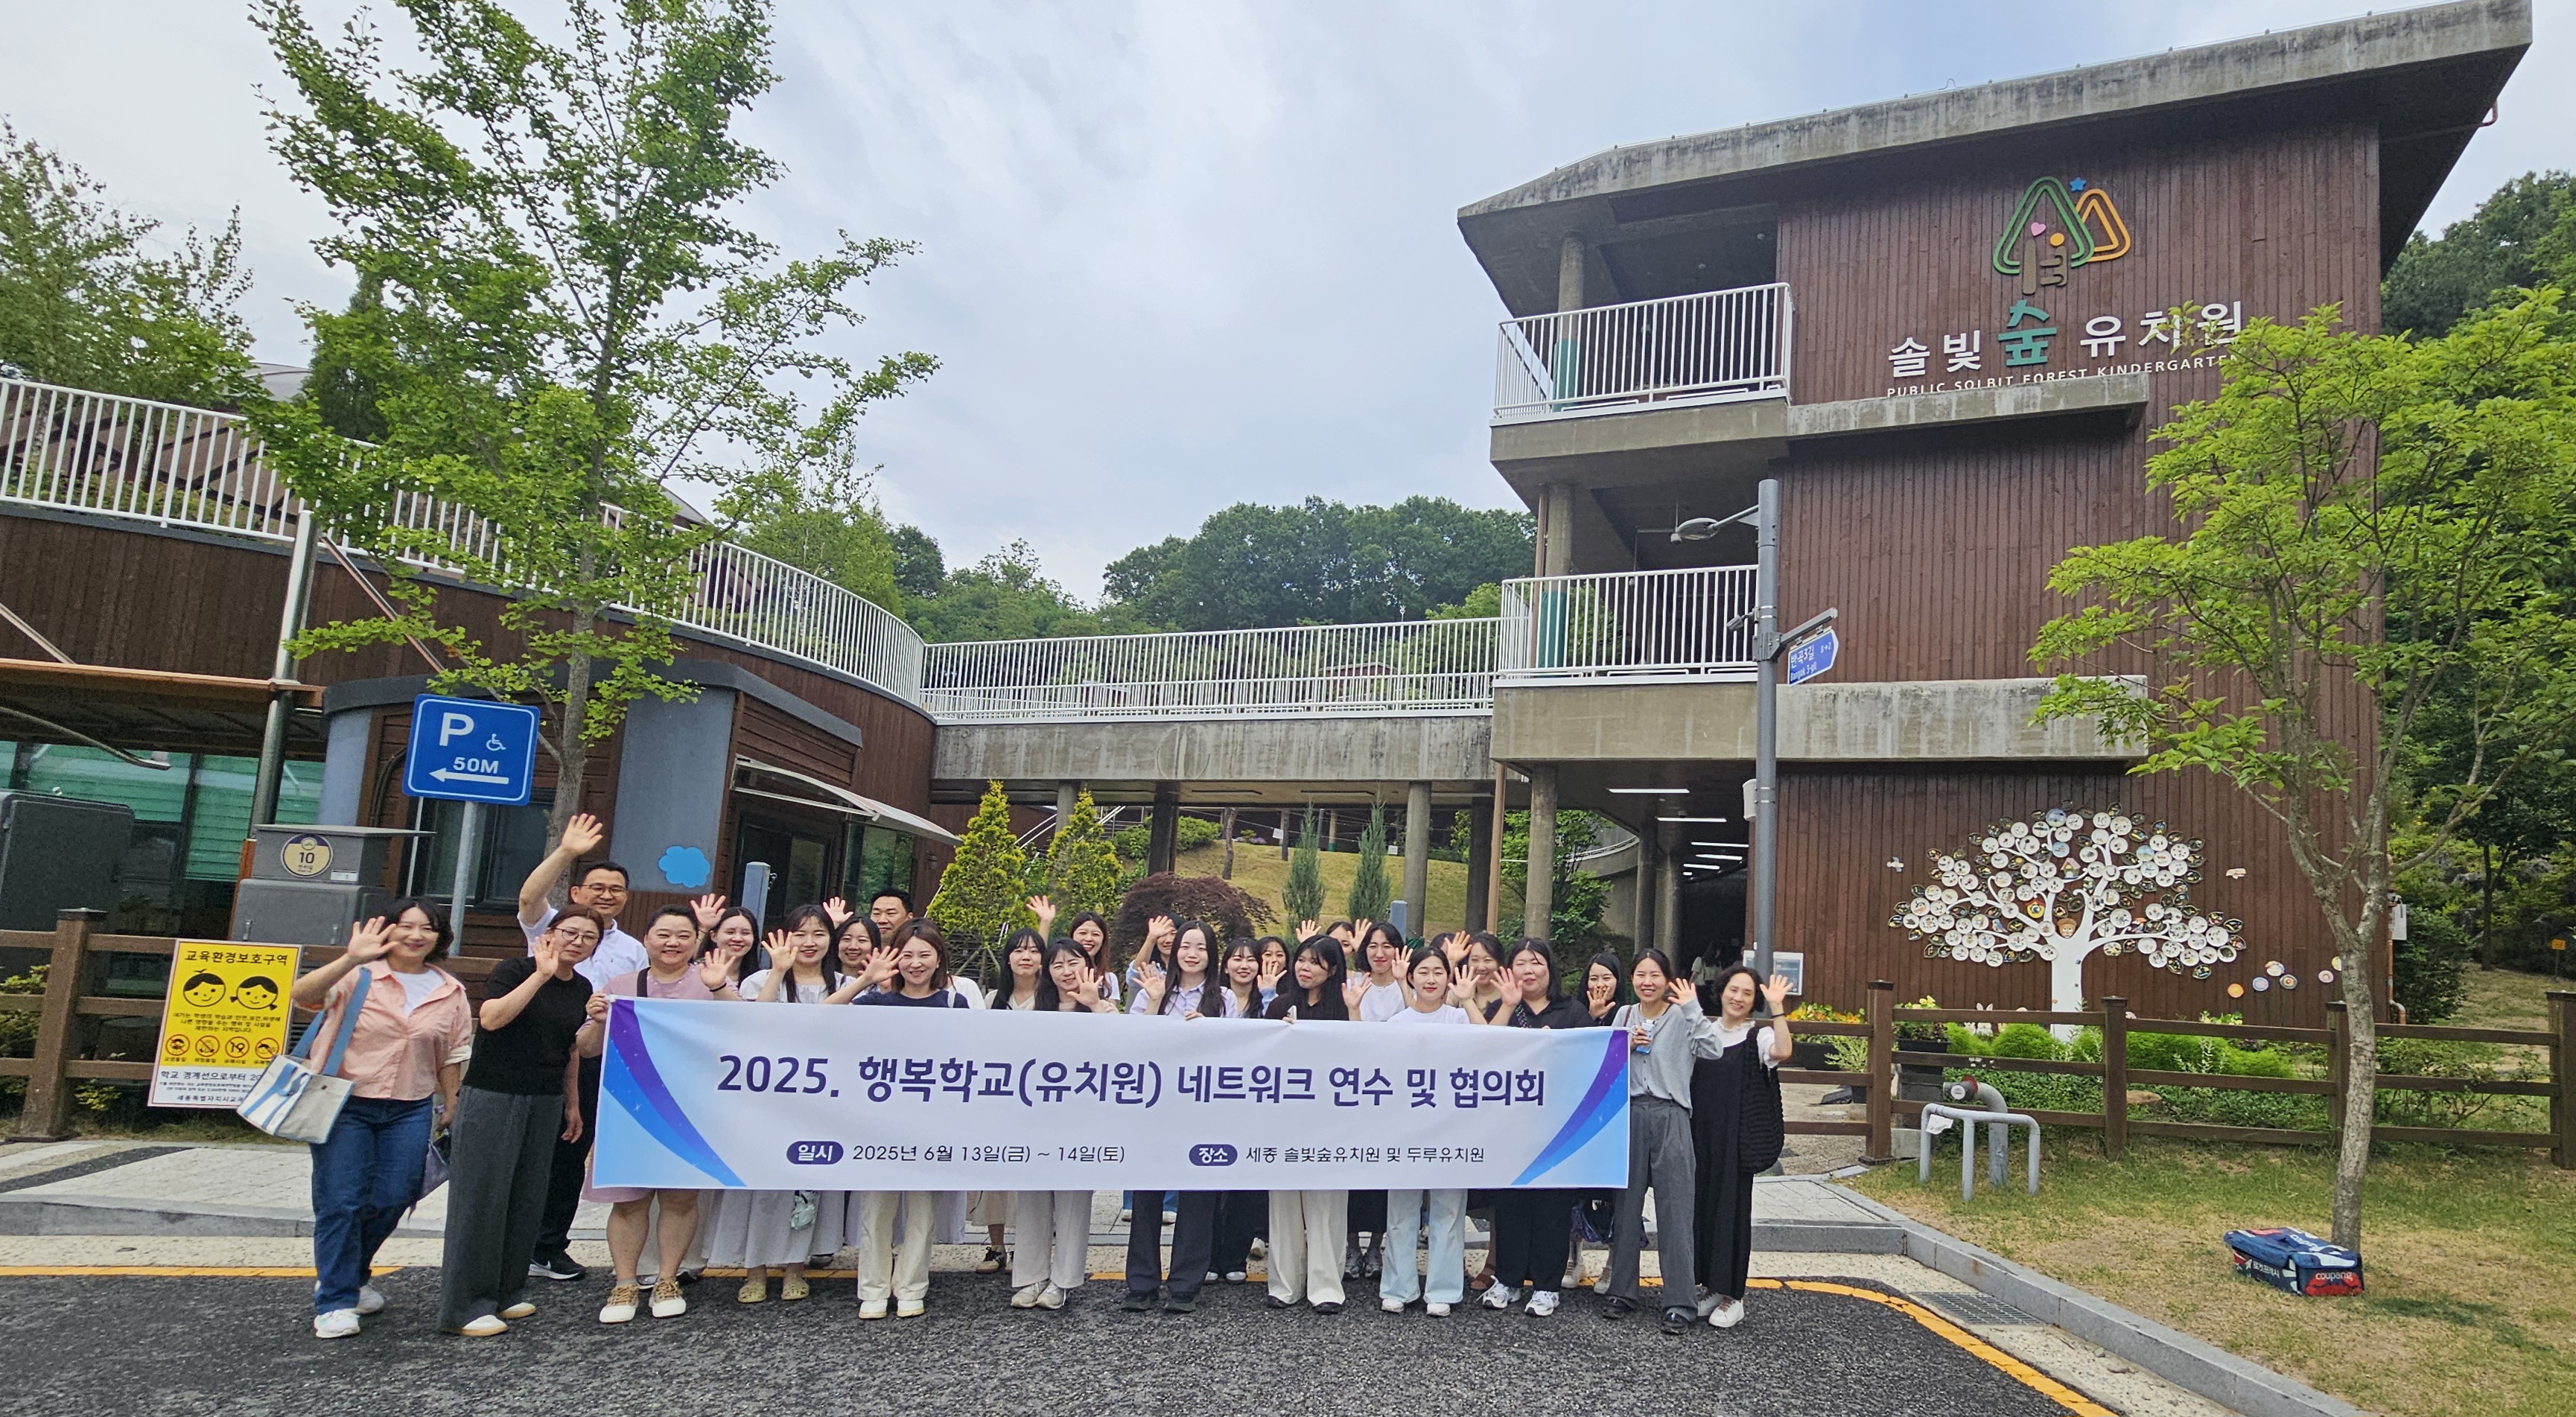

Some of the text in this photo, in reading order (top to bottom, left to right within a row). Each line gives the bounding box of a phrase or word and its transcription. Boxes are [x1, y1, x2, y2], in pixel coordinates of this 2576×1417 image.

[2023, 369, 2087, 383] FOREST
[1790, 644, 1814, 669] 반곡3길
[439, 712, 474, 747] P
[453, 757, 499, 774] 50M
[299, 852, 315, 864] 10
[184, 950, 288, 966] 교육환경보호구역
[161, 1071, 179, 1079] 학교
[182, 1071, 246, 1080] 경계선으로부터
[717, 1054, 1545, 1109] 2025. 행복학교(유치원) 네트워크 연수 및 협의회
[797, 1143, 833, 1162] 일시
[852, 1144, 917, 1162] 2025년
[923, 1145, 953, 1162] 6월
[961, 1144, 1031, 1163] 13일(금)
[1058, 1145, 1126, 1164] 14일(토)
[1198, 1146, 1485, 1164] 장소 세종 솔빛숲유치원 및 두루유치원
[2315, 1271, 2353, 1282] coupang
